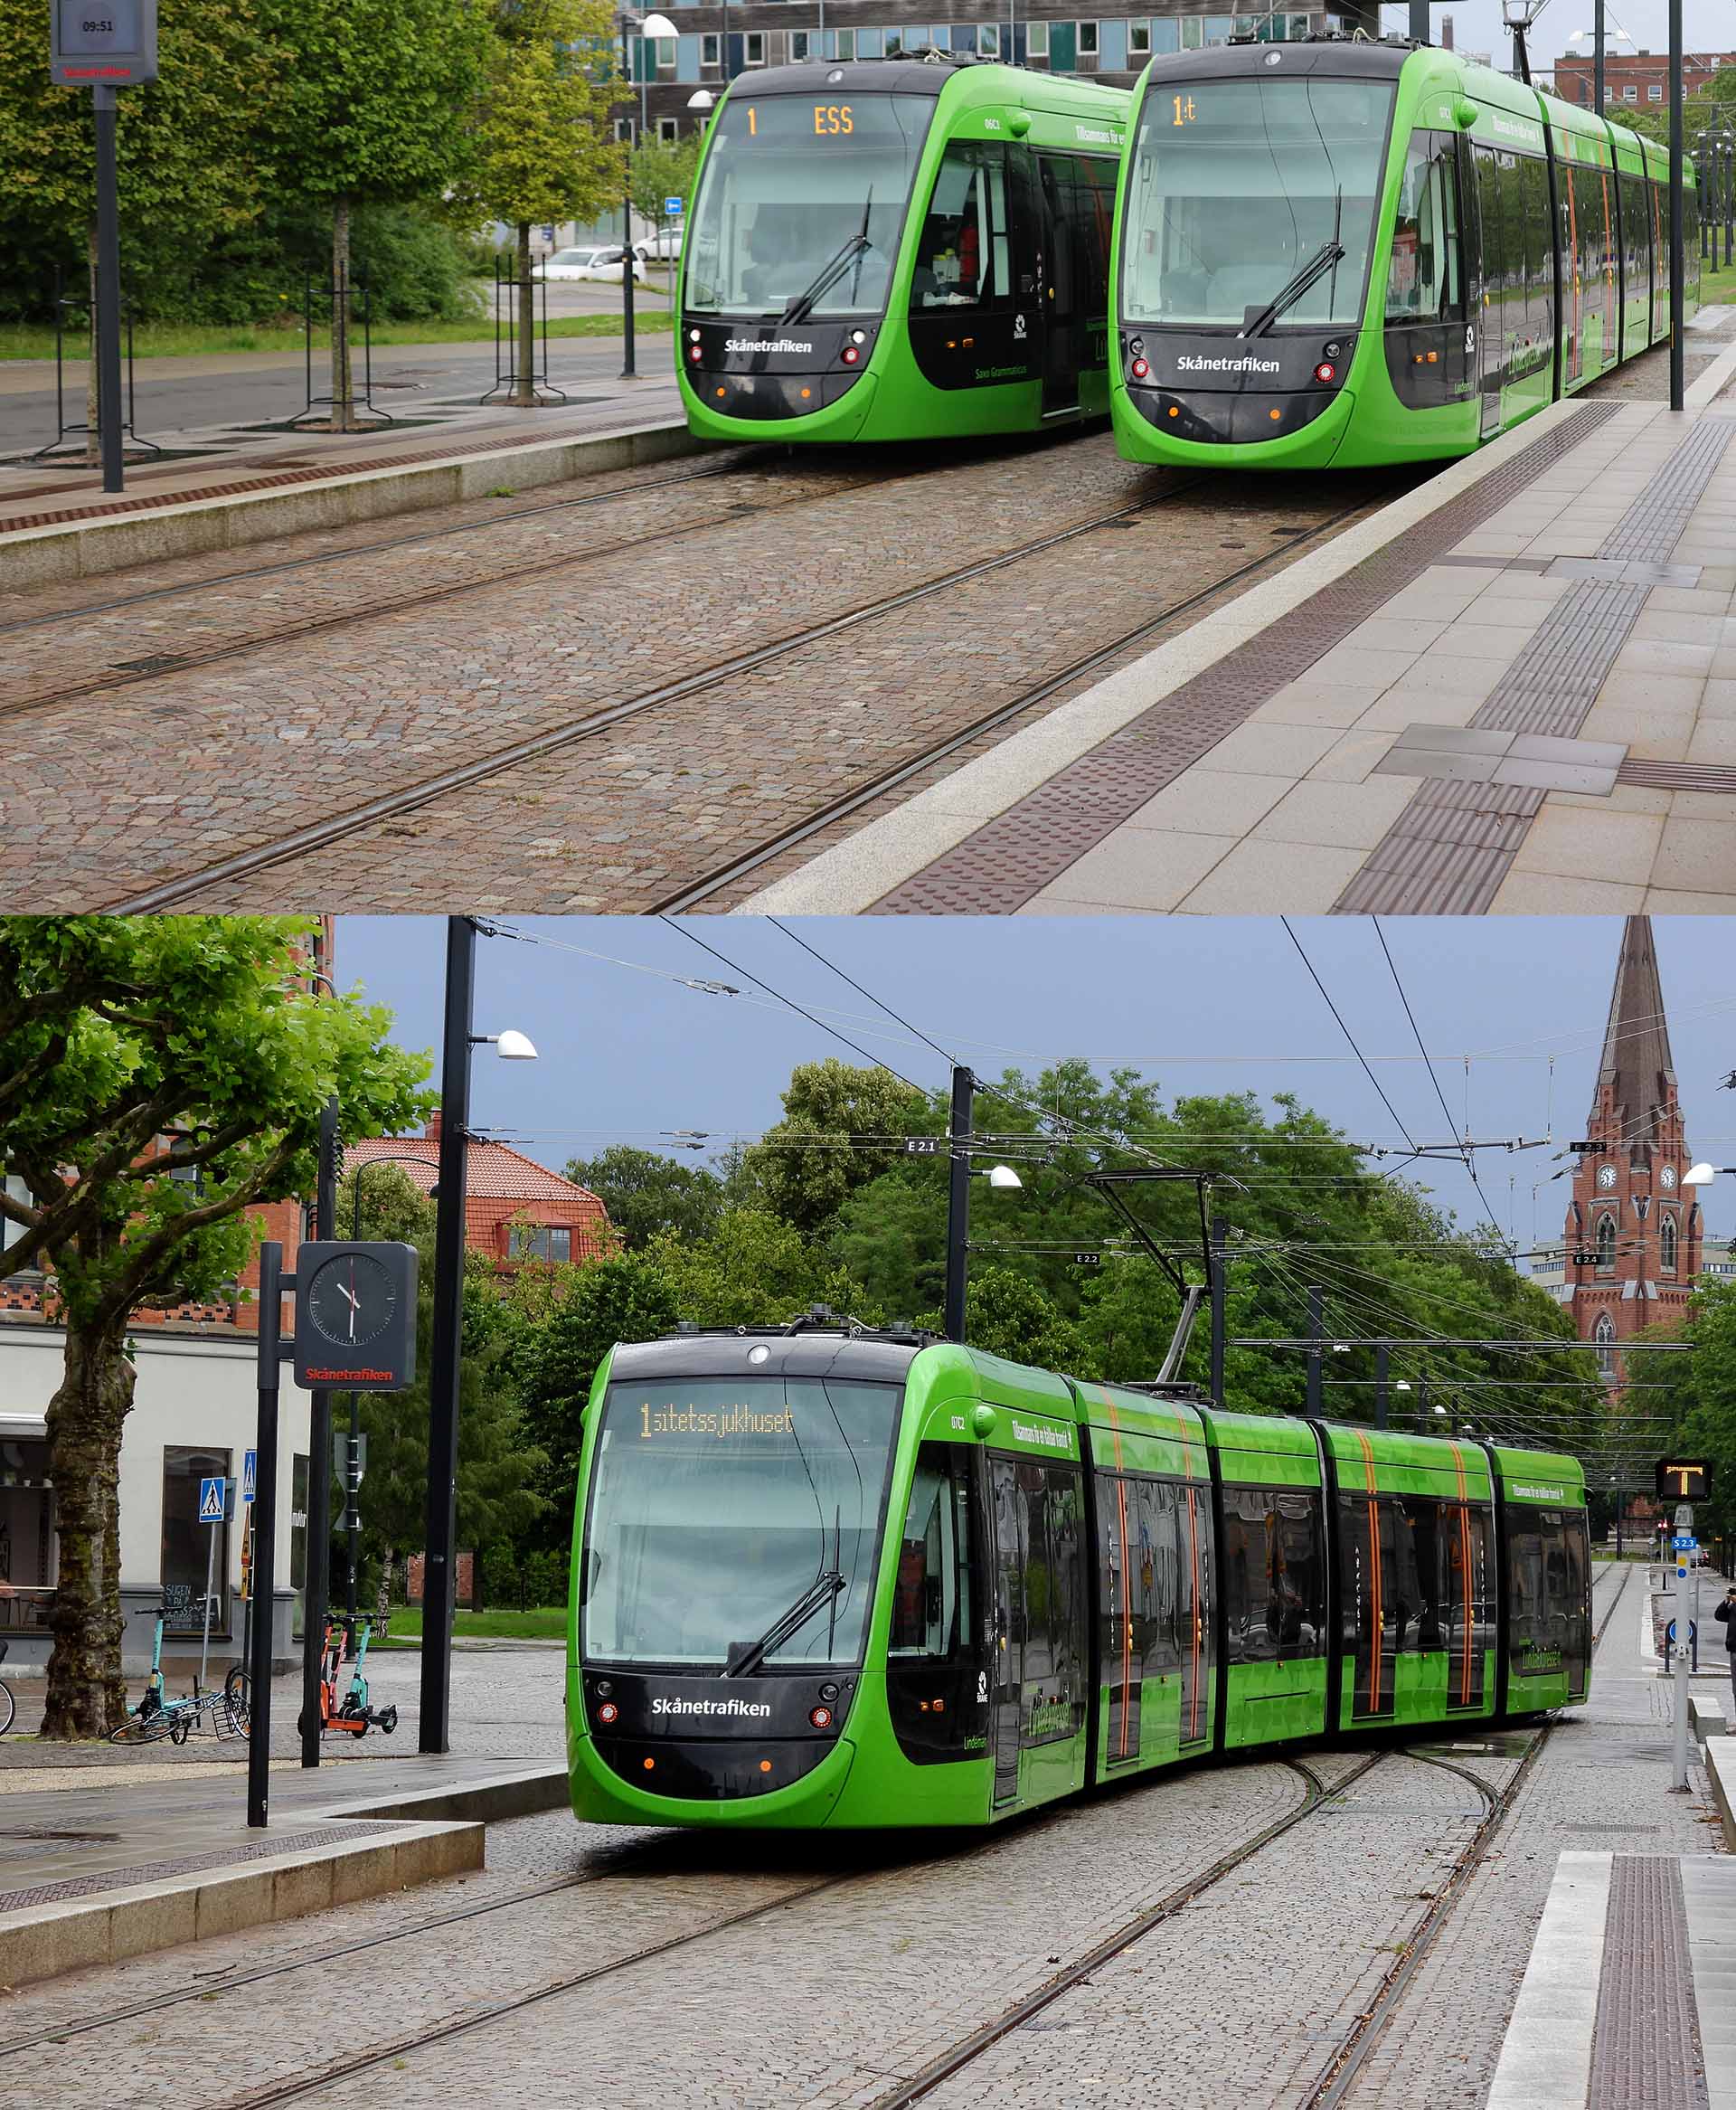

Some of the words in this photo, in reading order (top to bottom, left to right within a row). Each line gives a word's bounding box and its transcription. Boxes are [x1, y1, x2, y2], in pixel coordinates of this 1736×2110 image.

[82, 21, 113, 32] 09:51
[747, 108, 757, 136] 1
[814, 106, 854, 134] ESS
[724, 338, 812, 353] Skånetrafiken
[1176, 355, 1280, 373] Skånetrafiken
[908, 1141, 916, 1151] E
[918, 1141, 936, 1152] 2.1
[306, 1367, 392, 1381] Skånetrafiken
[1666, 1466, 1703, 1496] T
[1674, 1539, 1680, 1547] S
[1681, 1539, 1694, 1547] 2.3
[651, 1698, 770, 1717] Skånetrafiken
